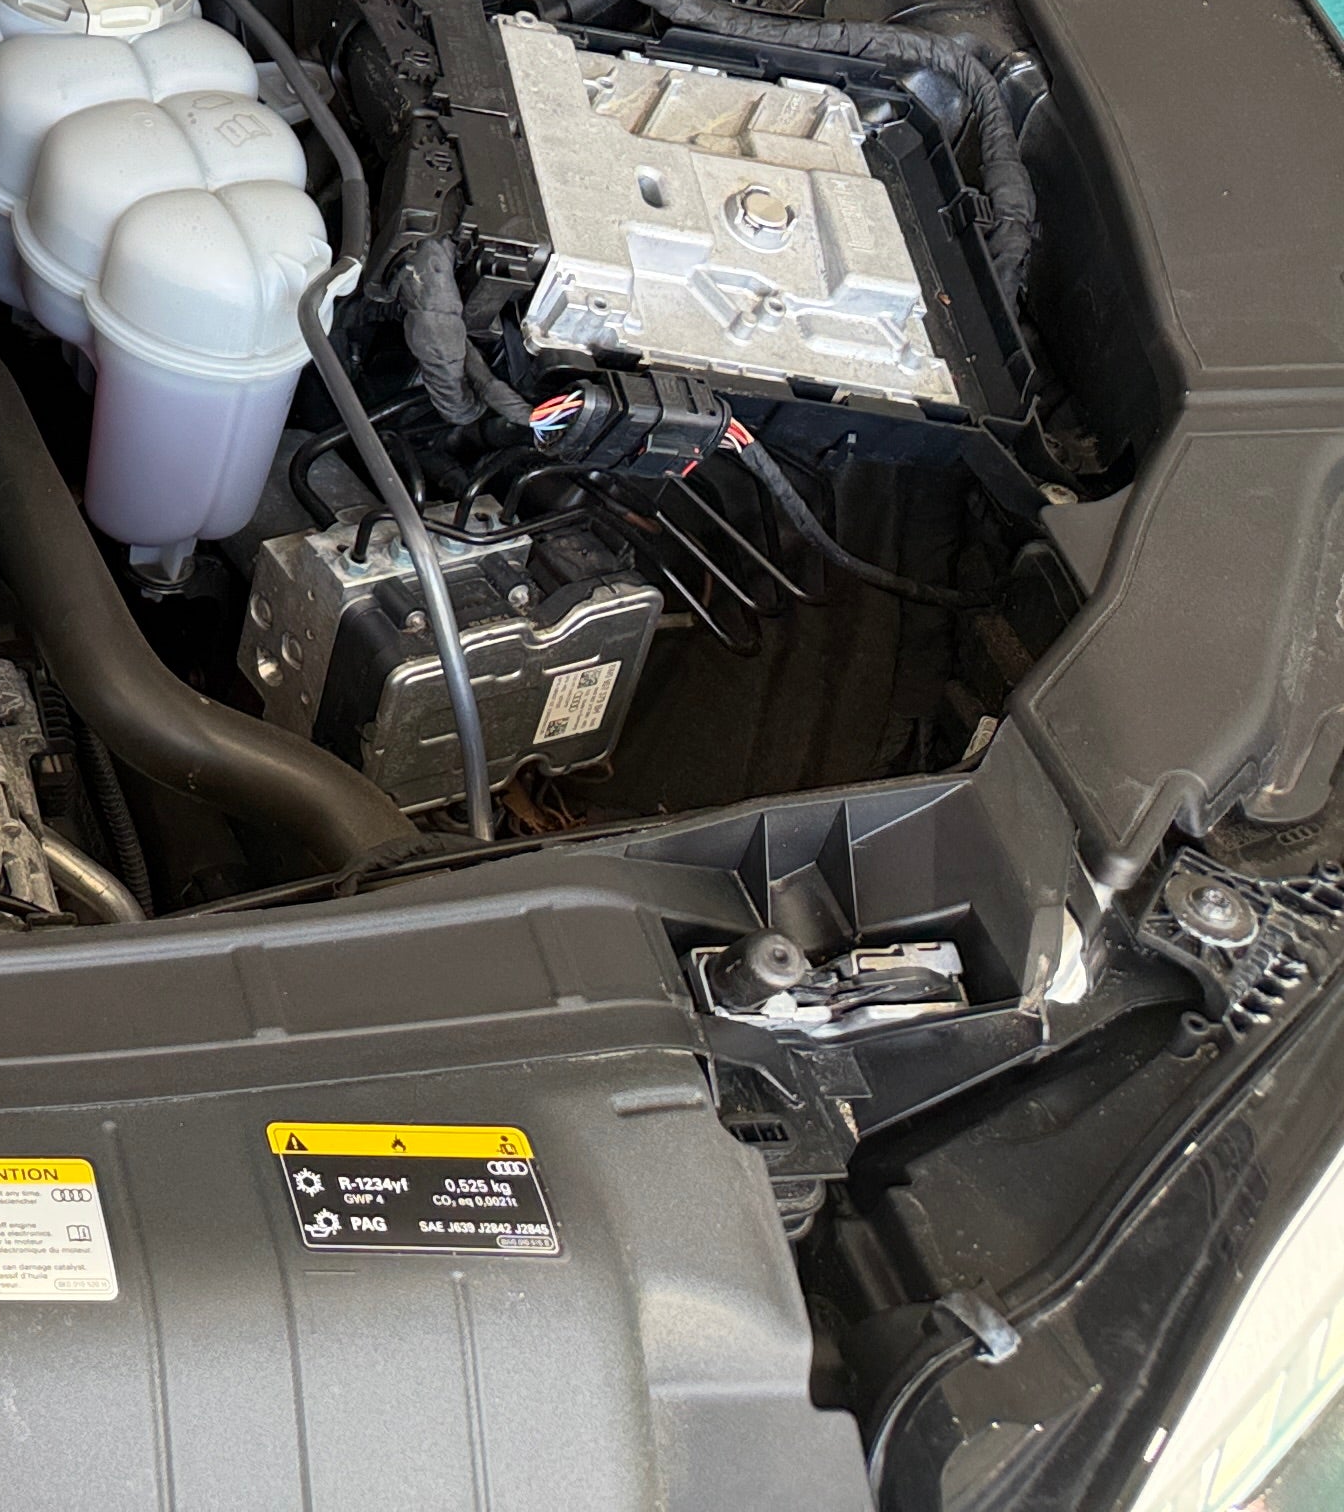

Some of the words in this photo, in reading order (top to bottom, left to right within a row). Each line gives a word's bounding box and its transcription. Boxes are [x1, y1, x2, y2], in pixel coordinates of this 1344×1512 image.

[338, 1176, 409, 1194] R-1234yf
[445, 1179, 488, 1193] 0,525
[490, 1179, 512, 1195] kg
[343, 1193, 374, 1204] GWP
[376, 1194, 384, 1204] 4
[458, 1197, 475, 1207] eq
[350, 1216, 388, 1231] PAG
[418, 1220, 445, 1232] SAE
[447, 1221, 475, 1233] J639
[478, 1222, 512, 1234] J2842
[515, 1223, 549, 1235] J2845
